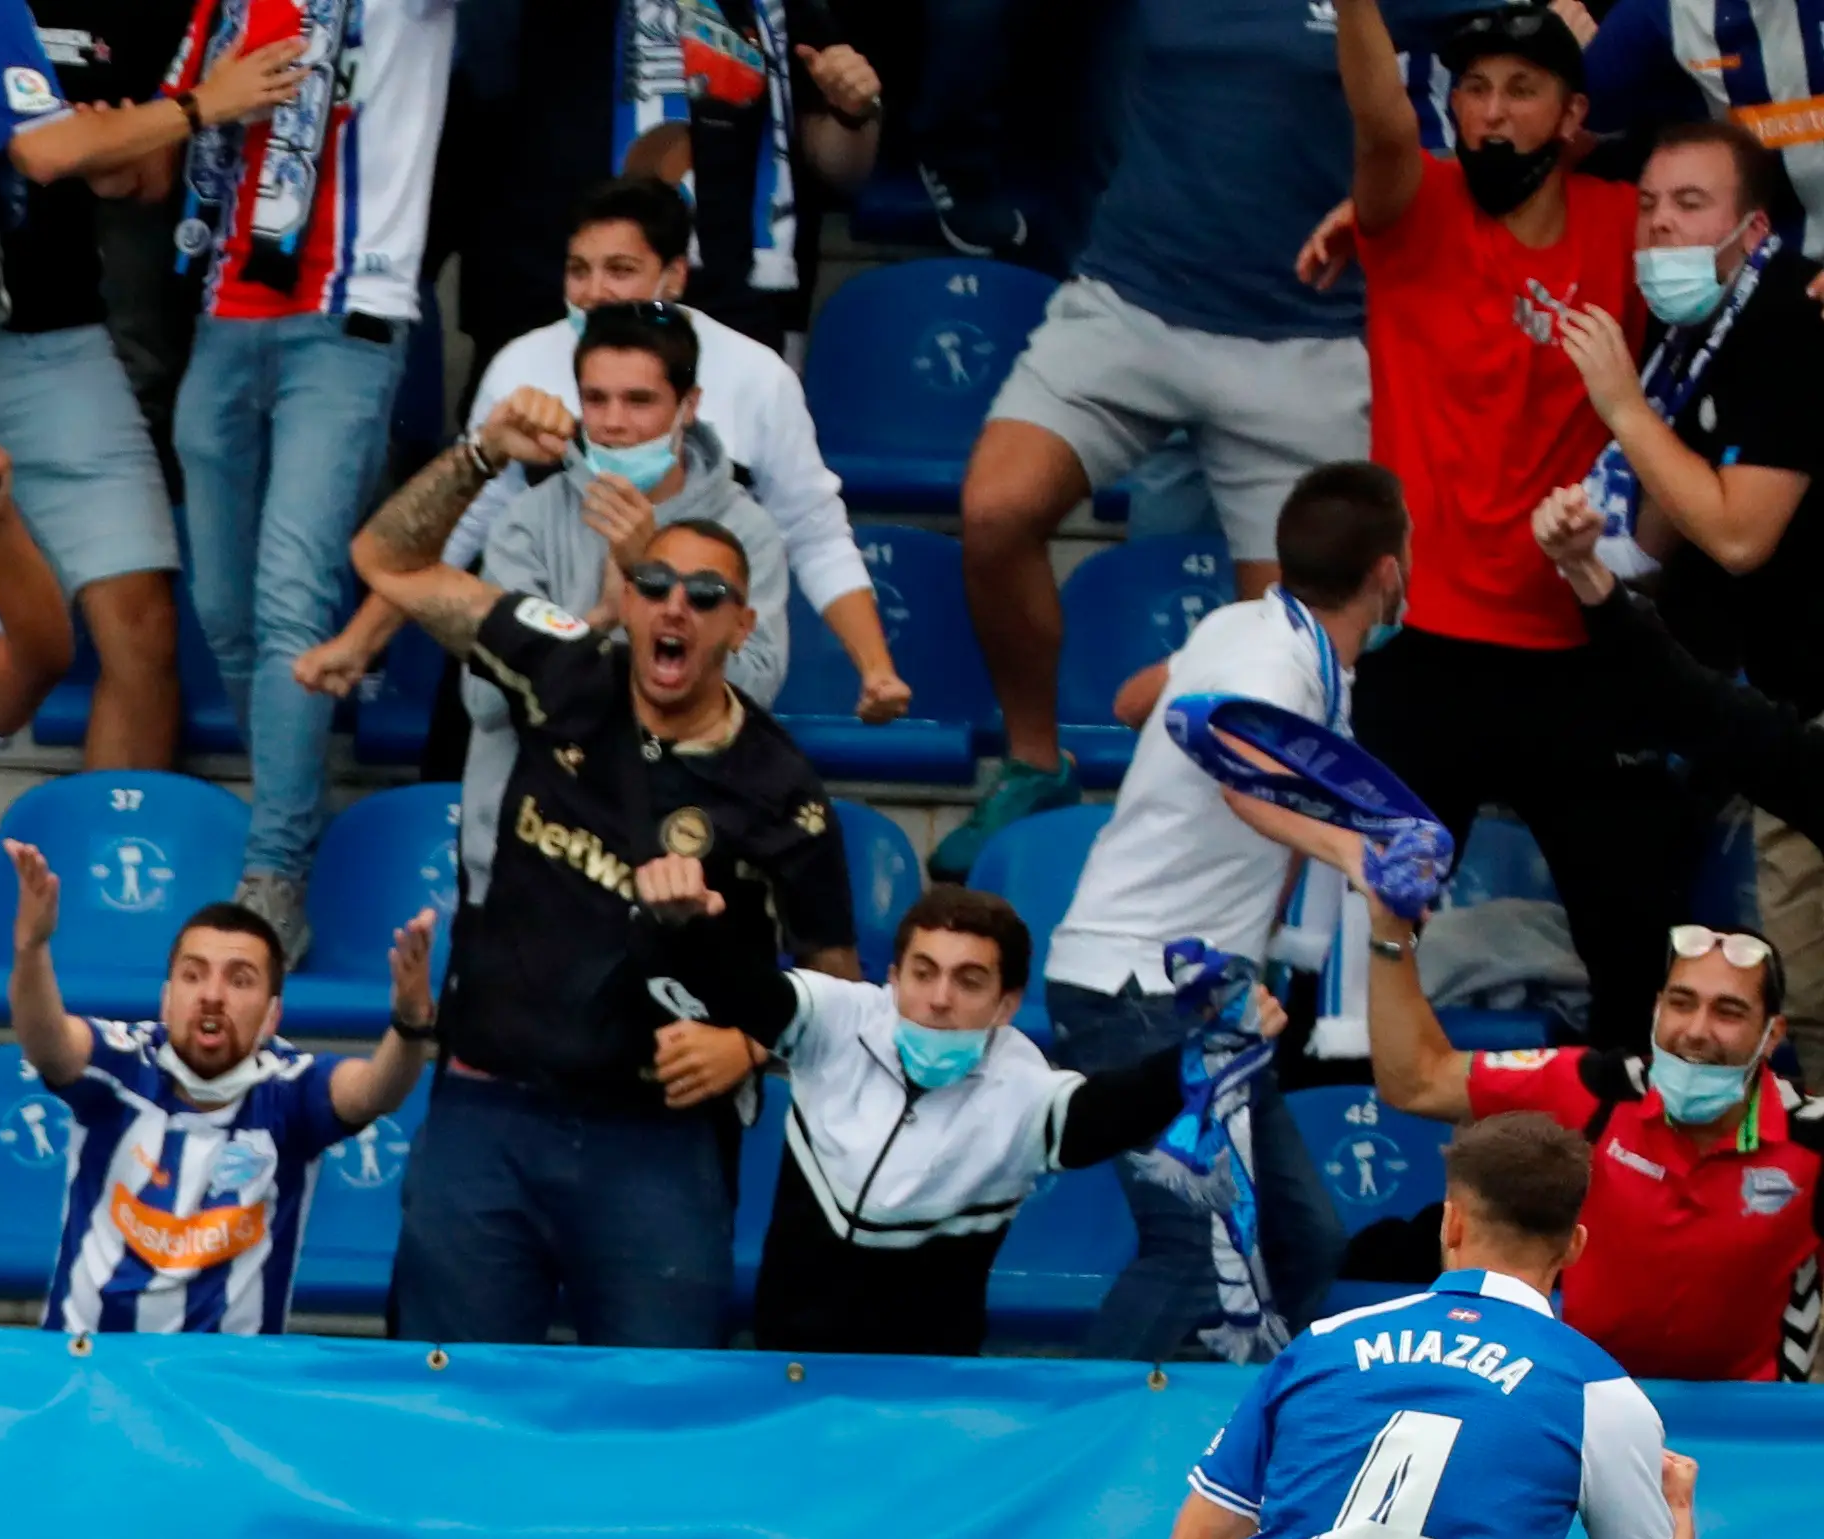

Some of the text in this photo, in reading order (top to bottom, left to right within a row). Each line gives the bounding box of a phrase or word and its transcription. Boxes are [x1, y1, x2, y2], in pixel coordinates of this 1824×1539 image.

[110, 789, 144, 811] 37
[515, 794, 634, 901] betw
[1354, 1328, 1534, 1396] MIAZGA
